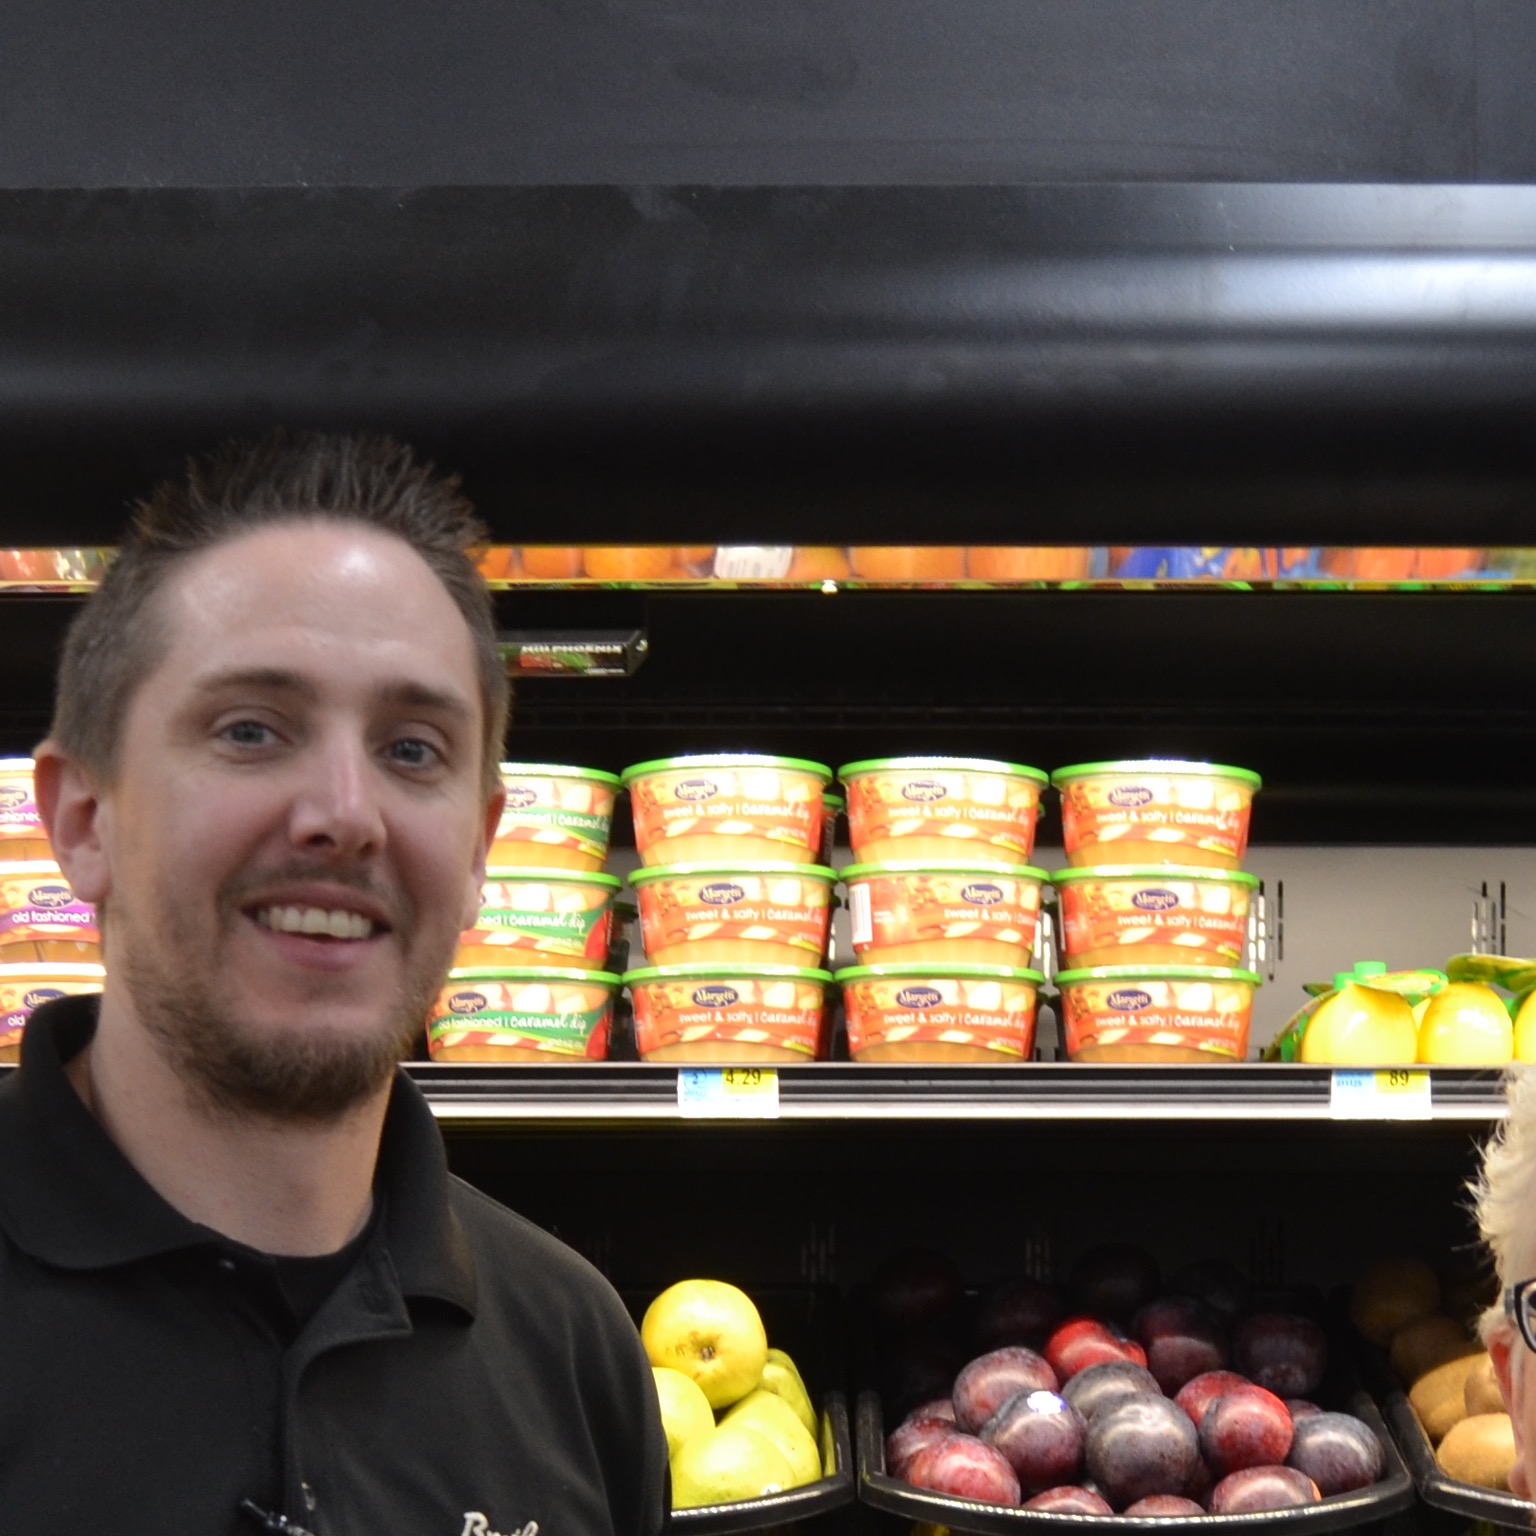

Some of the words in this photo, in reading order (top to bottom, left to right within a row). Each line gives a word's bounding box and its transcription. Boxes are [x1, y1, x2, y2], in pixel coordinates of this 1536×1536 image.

[664, 806, 694, 819] sweet
[12, 911, 28, 924] old
[31, 910, 89, 924] fashioned
[686, 909, 717, 921] sweet
[7, 1015, 25, 1027] old
[679, 1011, 709, 1024] sweet
[883, 1014, 916, 1026] sweet
[1095, 1016, 1127, 1028] sweet
